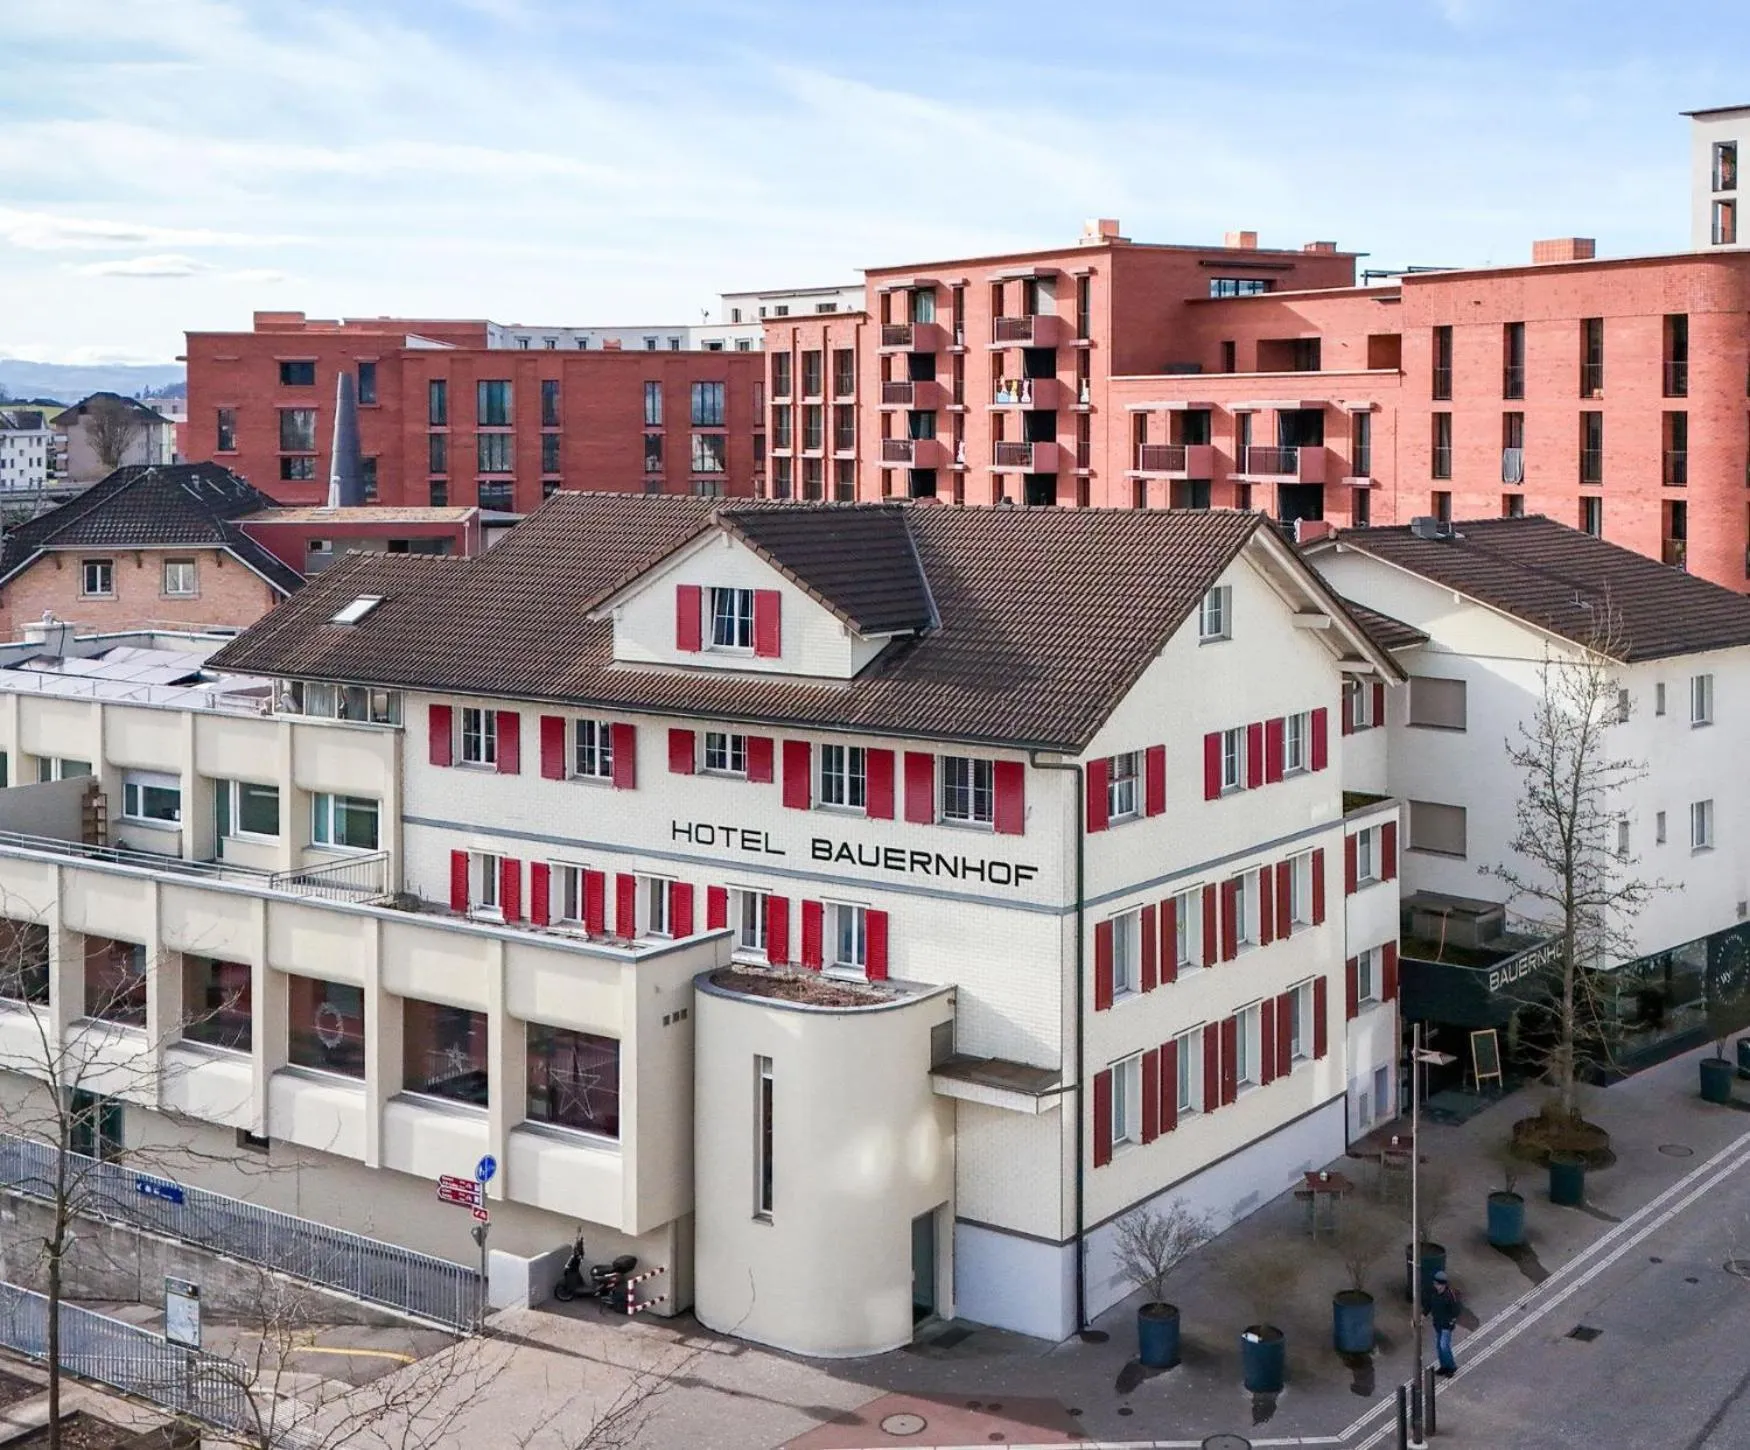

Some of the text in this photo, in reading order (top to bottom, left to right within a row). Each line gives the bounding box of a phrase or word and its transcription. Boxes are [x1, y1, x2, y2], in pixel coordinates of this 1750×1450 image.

[671, 819, 1039, 887] HOTEL BAUERNHOF
[1489, 938, 1565, 992] BAUERNHO
